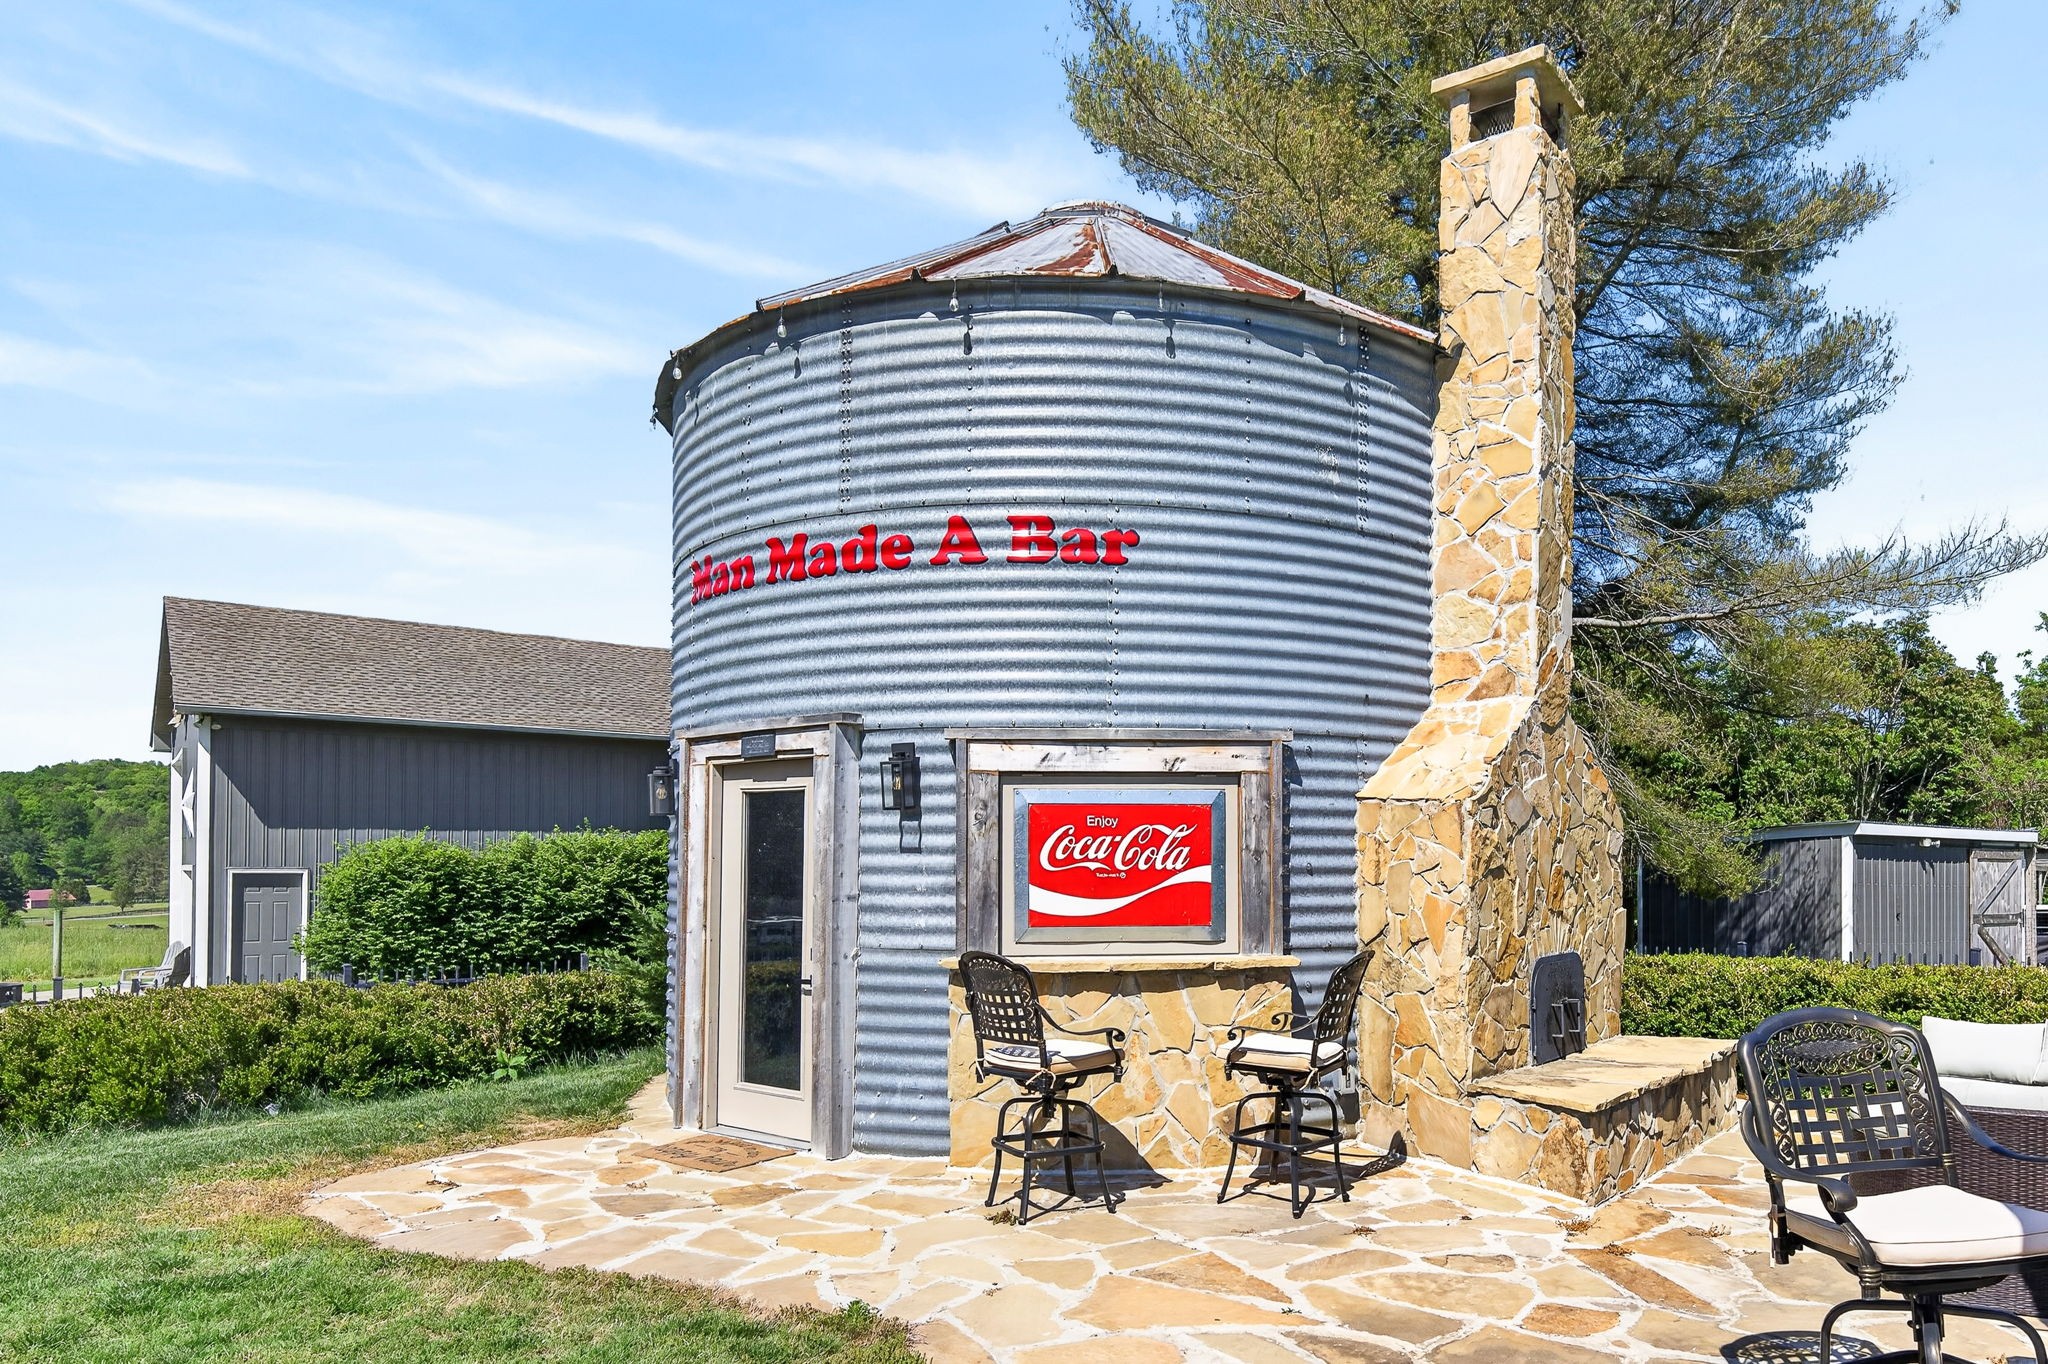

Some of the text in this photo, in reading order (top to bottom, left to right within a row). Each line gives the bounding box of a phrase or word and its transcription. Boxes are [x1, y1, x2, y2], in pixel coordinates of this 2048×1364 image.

[691, 514, 1140, 604] Man Made A Bar
[1086, 815, 1119, 828] Enjoy
[1039, 823, 1198, 872] Coca-Cola
